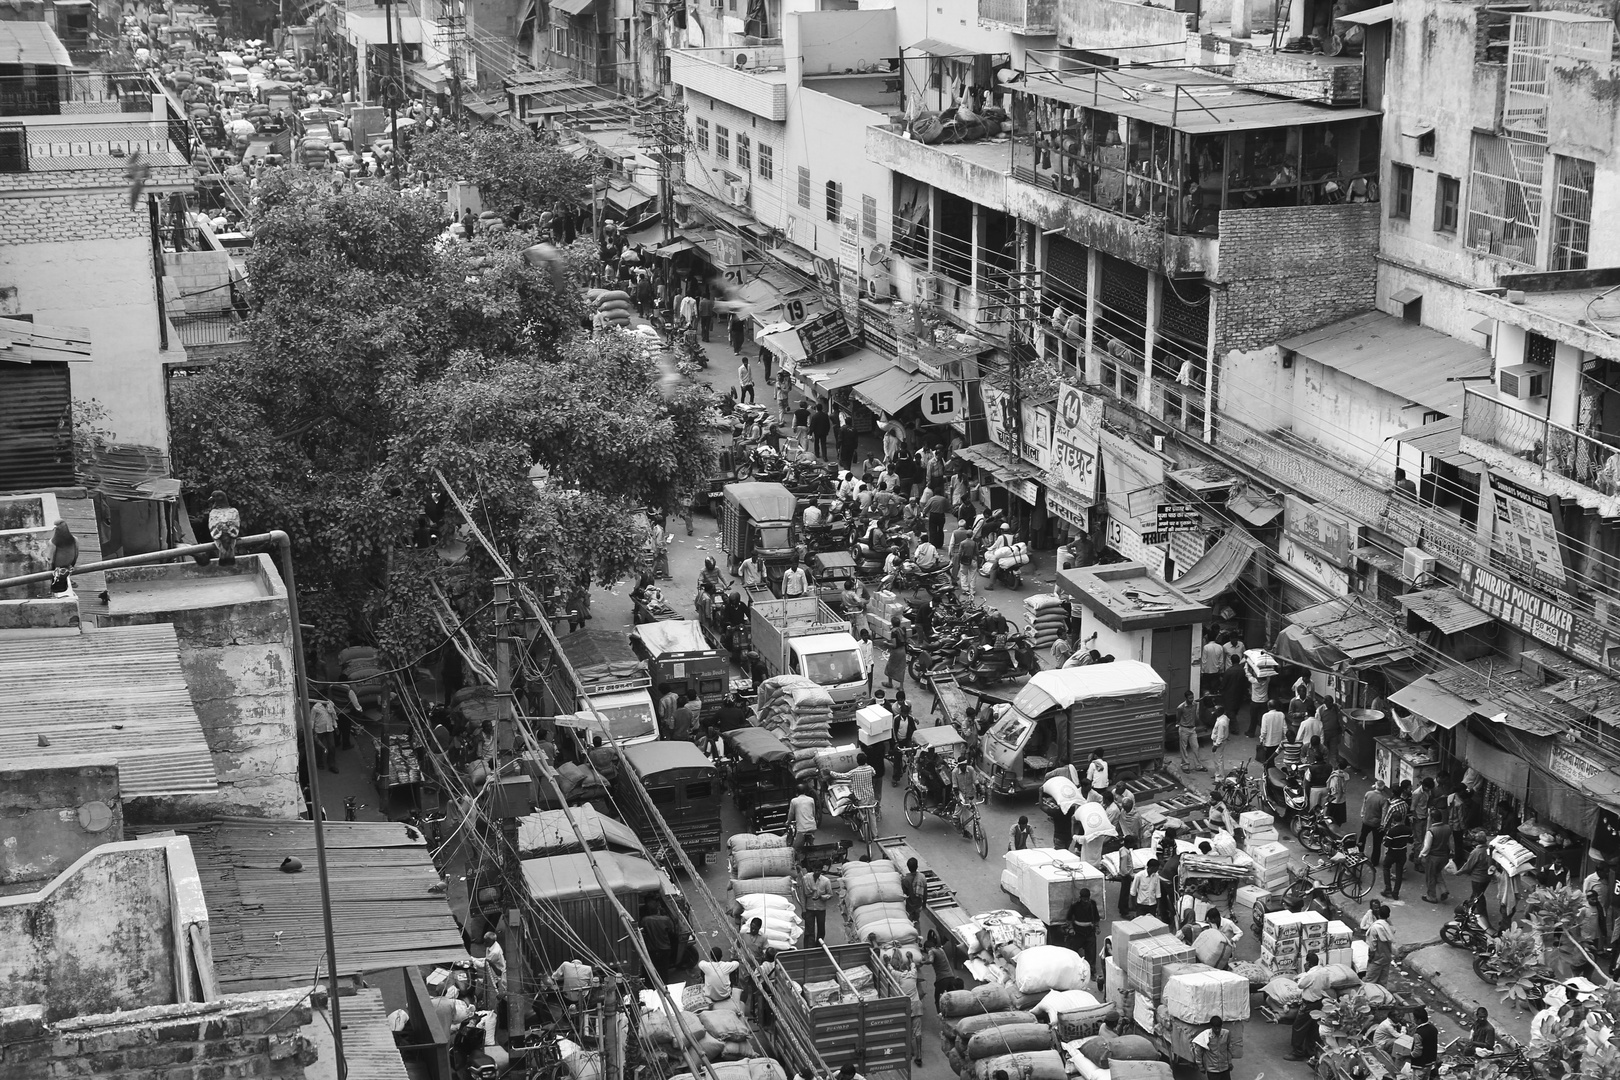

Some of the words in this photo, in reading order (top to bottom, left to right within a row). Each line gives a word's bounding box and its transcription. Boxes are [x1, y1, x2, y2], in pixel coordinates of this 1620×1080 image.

[725, 270, 744, 285] 21
[786, 300, 804, 322] 19
[929, 391, 954, 415] 15
[1064, 395, 1079, 424] 14
[1048, 497, 1085, 527] मसाले
[1110, 521, 1122, 544] 13
[1475, 567, 1510, 601] SUNRAYS
[1511, 586, 1540, 617] POUCH
[1541, 601, 1573, 633] MAKER
[1546, 625, 1557, 636] KG
